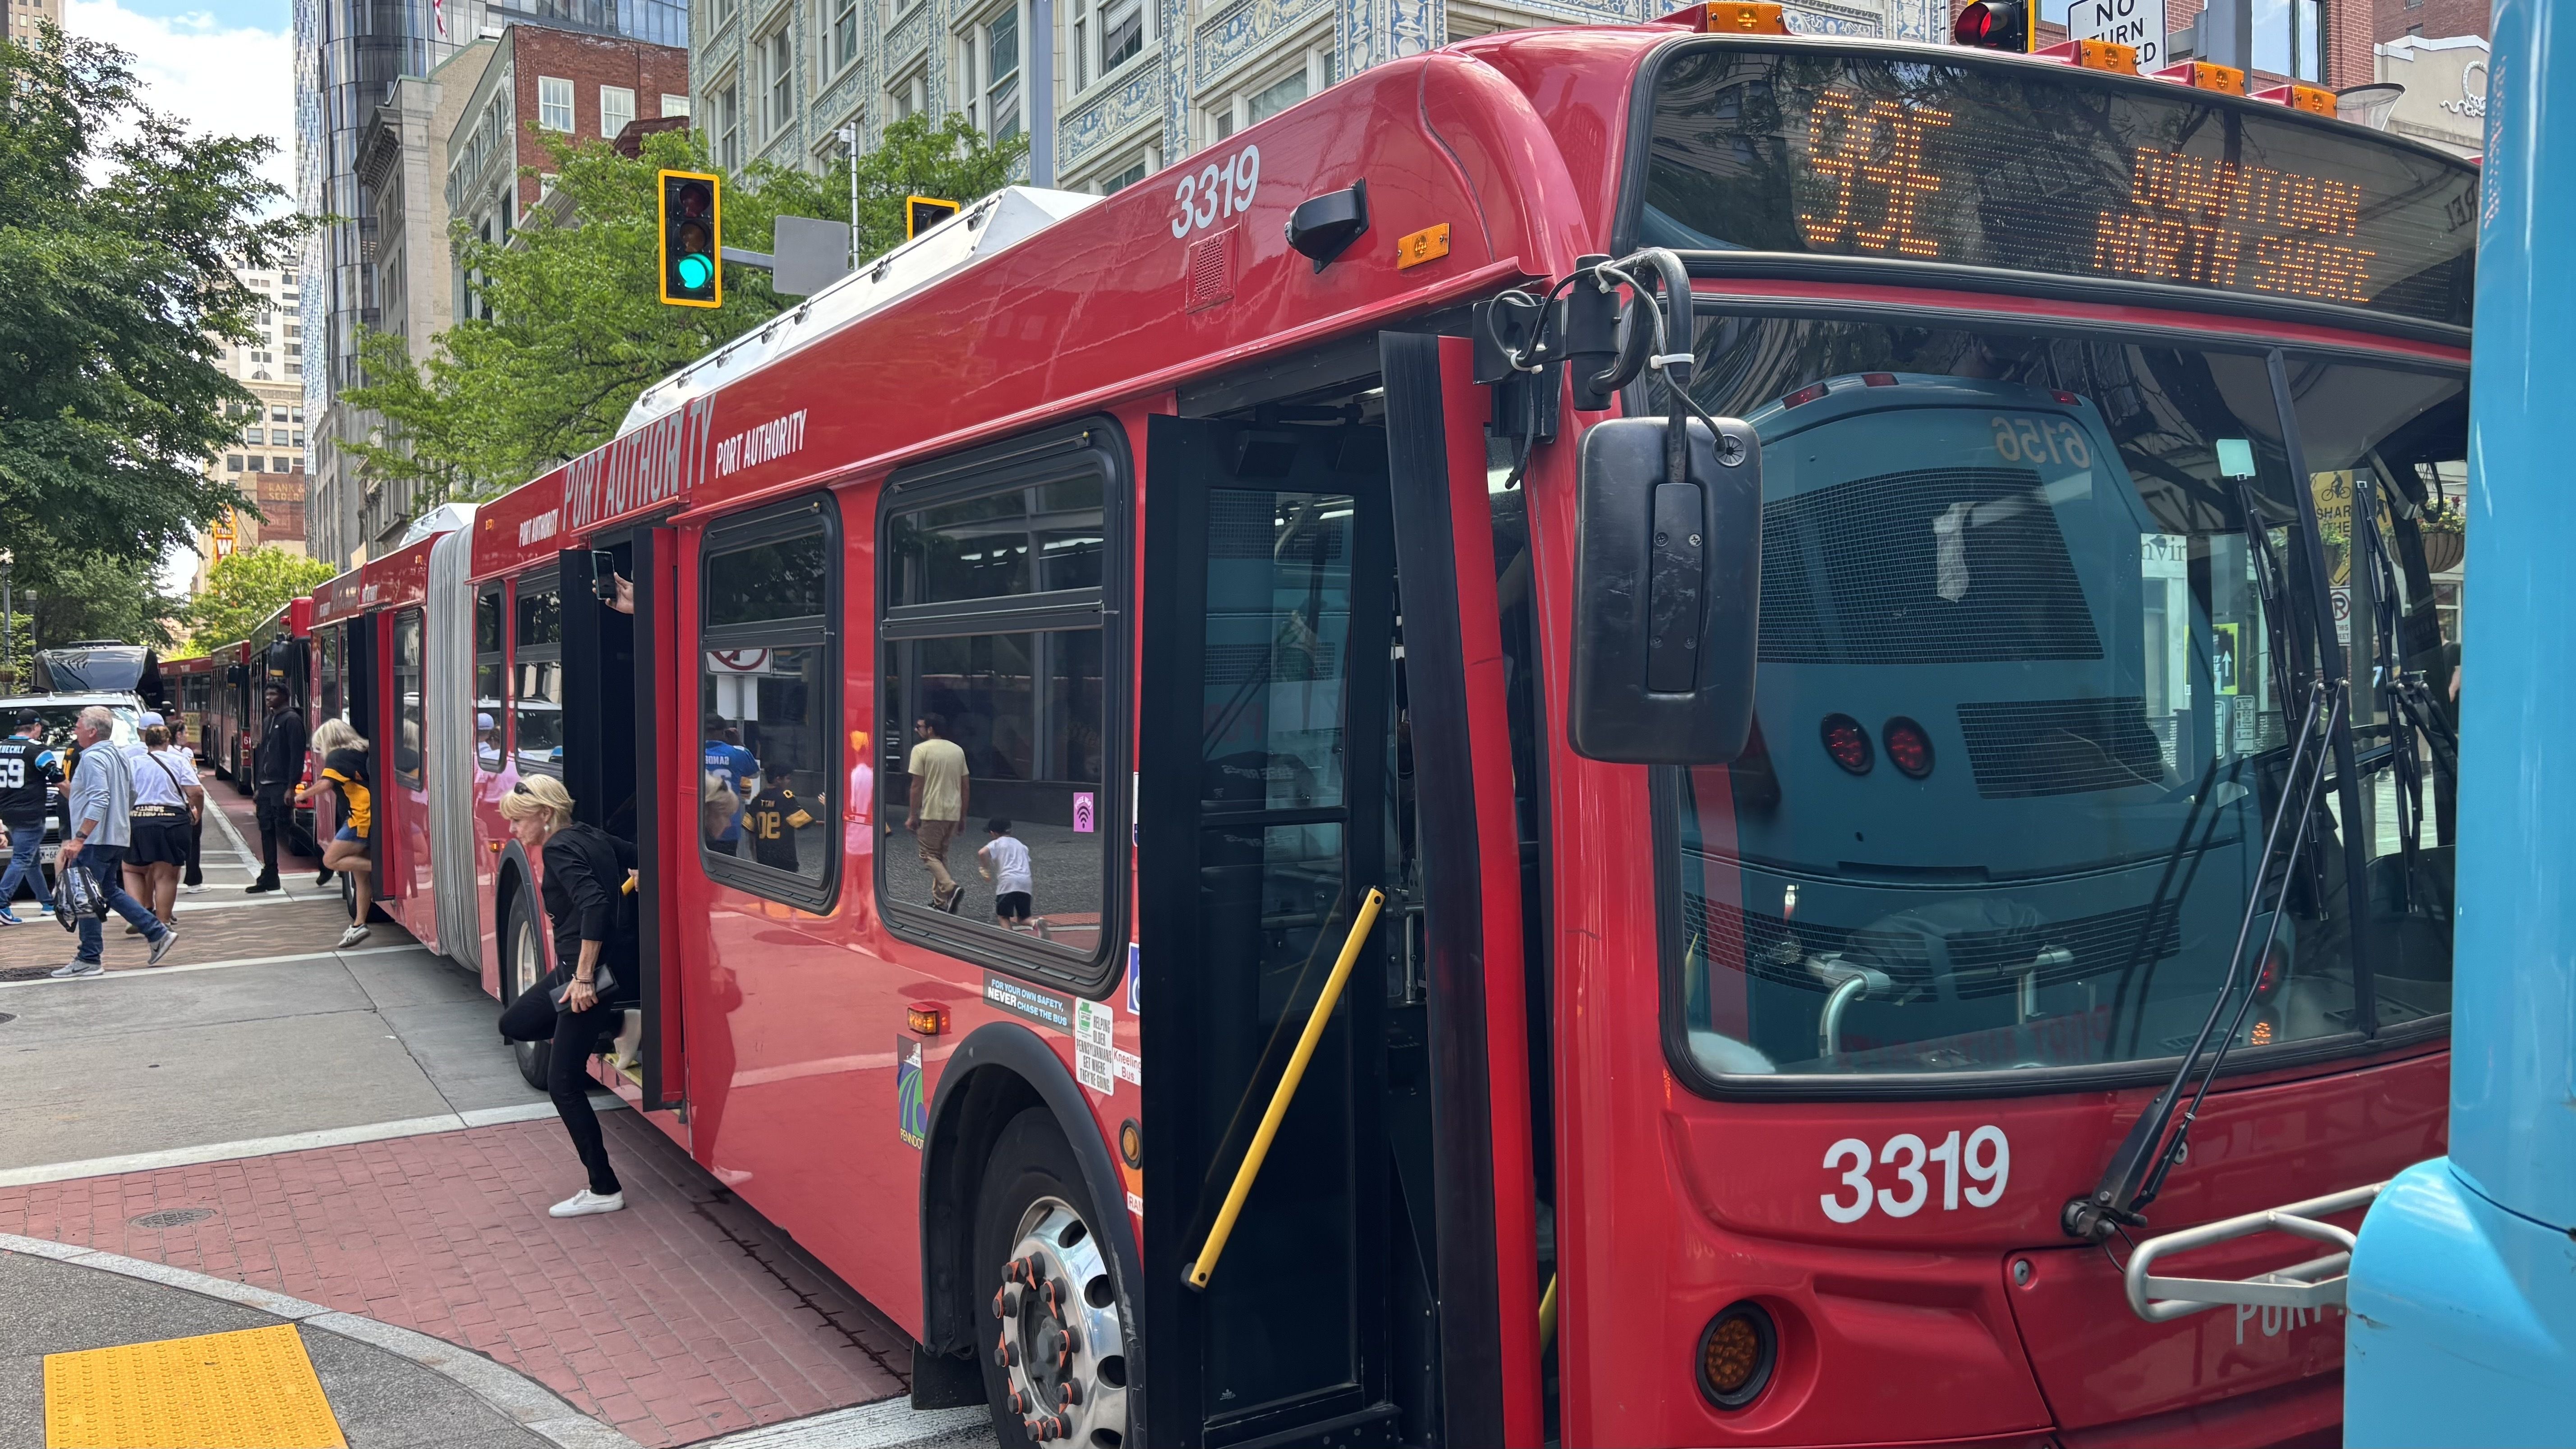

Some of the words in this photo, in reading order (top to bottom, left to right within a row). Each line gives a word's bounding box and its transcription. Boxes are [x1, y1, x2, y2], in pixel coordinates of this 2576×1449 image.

[2097, 0, 2134, 26] NO
[1801, 91, 1952, 256] 99E
[1172, 144, 1260, 239] 3319
[2132, 147, 2360, 237] DOWNTOWN
[2094, 211, 2240, 285] NORTH
[2253, 235, 2376, 302] SHORE
[715, 433, 743, 479] PORT
[743, 409, 807, 469] AUTHORITY
[562, 448, 605, 531] PORT
[604, 393, 716, 518] AUTHORITY
[2316, 505, 2351, 520] SHAR
[519, 519, 532, 547] PORT
[988, 987, 1017, 1007] NEVER
[1017, 1001, 1039, 1016] CHASE
[1039, 1008, 1052, 1021] THE
[1053, 1014, 1067, 1026] BUS
[991, 979, 1004, 989] FOR
[1004, 983, 1021, 996] YOUR
[1021, 989, 1036, 1002] OWN
[1037, 994, 1064, 1012] SAFETY,
[1093, 1016, 1110, 1034] HELPING
[1093, 1030, 1106, 1046] OLDER
[1076, 1039, 1112, 1064] PENNSYLVANIANS
[1114, 1049, 1141, 1073] Kneeling
[1080, 1068, 1096, 1086] THEY'RE
[1092, 1058, 1105, 1076] WHERE
[1122, 1066, 1135, 1081] Bus
[900, 1128, 925, 1150] PENNDOT
[1820, 1125, 2010, 1224] 3319
